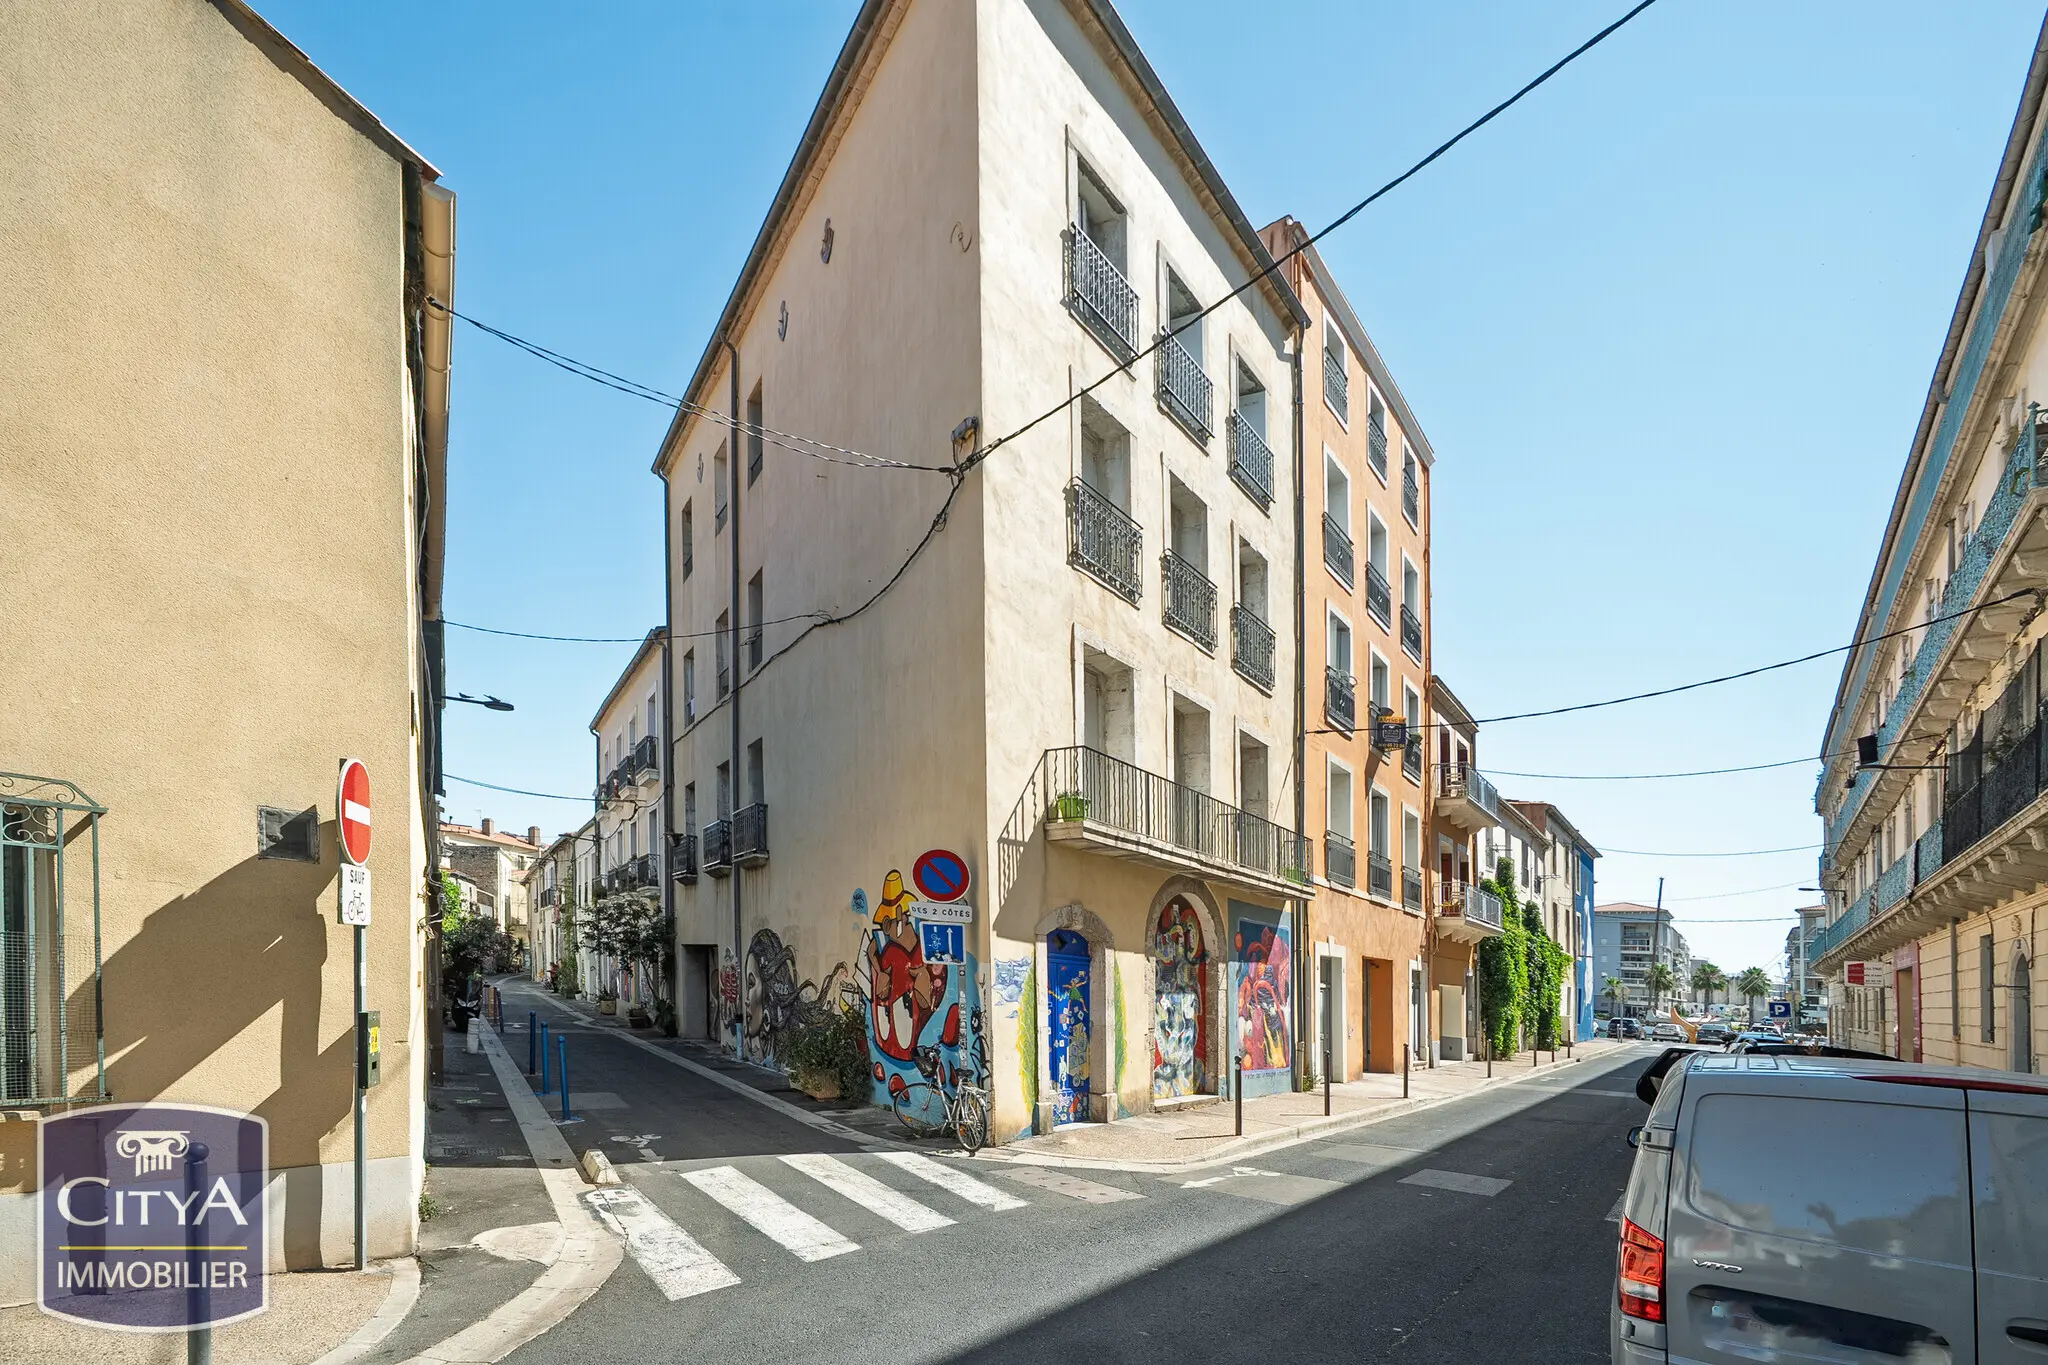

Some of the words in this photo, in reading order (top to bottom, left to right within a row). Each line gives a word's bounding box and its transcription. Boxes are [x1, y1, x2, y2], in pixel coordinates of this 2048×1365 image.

[350, 869, 364, 885] SAUF
[911, 906, 928, 914] DES
[942, 908, 970, 918] CÔTÉS
[1775, 1005, 1785, 1015] P
[1692, 1258, 1743, 1273] VITO
